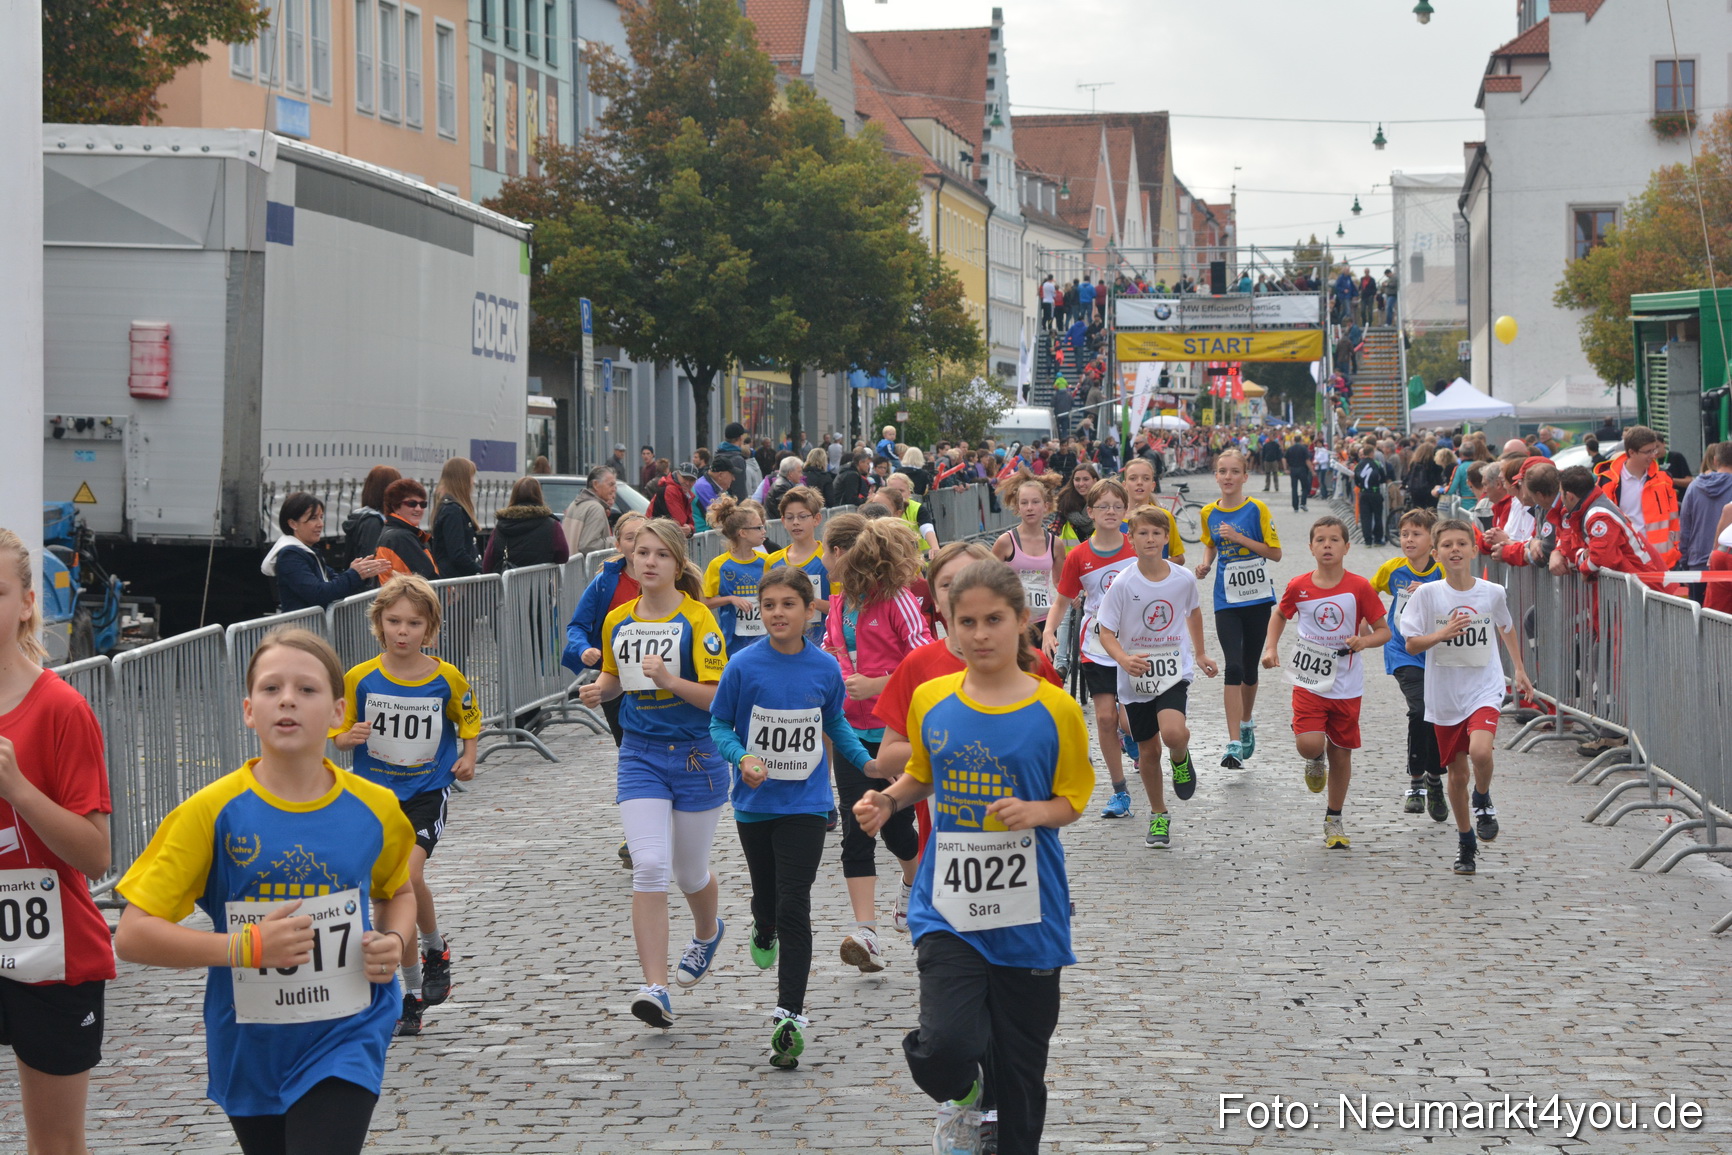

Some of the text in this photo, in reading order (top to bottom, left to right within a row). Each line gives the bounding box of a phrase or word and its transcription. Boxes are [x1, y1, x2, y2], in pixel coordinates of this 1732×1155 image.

[472, 292, 518, 361] BOCK
[1183, 337, 1254, 355] START
[1228, 568, 1265, 587] 4009
[1238, 588, 1259, 596] Louisa
[736, 607, 761, 621] 402
[745, 624, 760, 632] Katja
[618, 638, 673, 664] 4102
[704, 657, 724, 667] PARTL
[1140, 658, 1178, 678] 003
[1292, 651, 1332, 676] 4043
[1135, 681, 1160, 694] ALEX
[367, 700, 430, 712] PARTL Neumarkt
[752, 712, 811, 724] PARTL Neumarkt
[372, 712, 432, 740] 4101
[755, 726, 816, 753] 4048
[760, 757, 808, 770] Valentina
[236, 836, 247, 844] 15
[937, 841, 1017, 852] PARTL Neumarkt
[231, 845, 253, 855] Jahre
[943, 853, 1028, 893] 4022
[969, 903, 1001, 916] Sara
[229, 913, 265, 925] PART
[275, 985, 330, 1006] Judith
